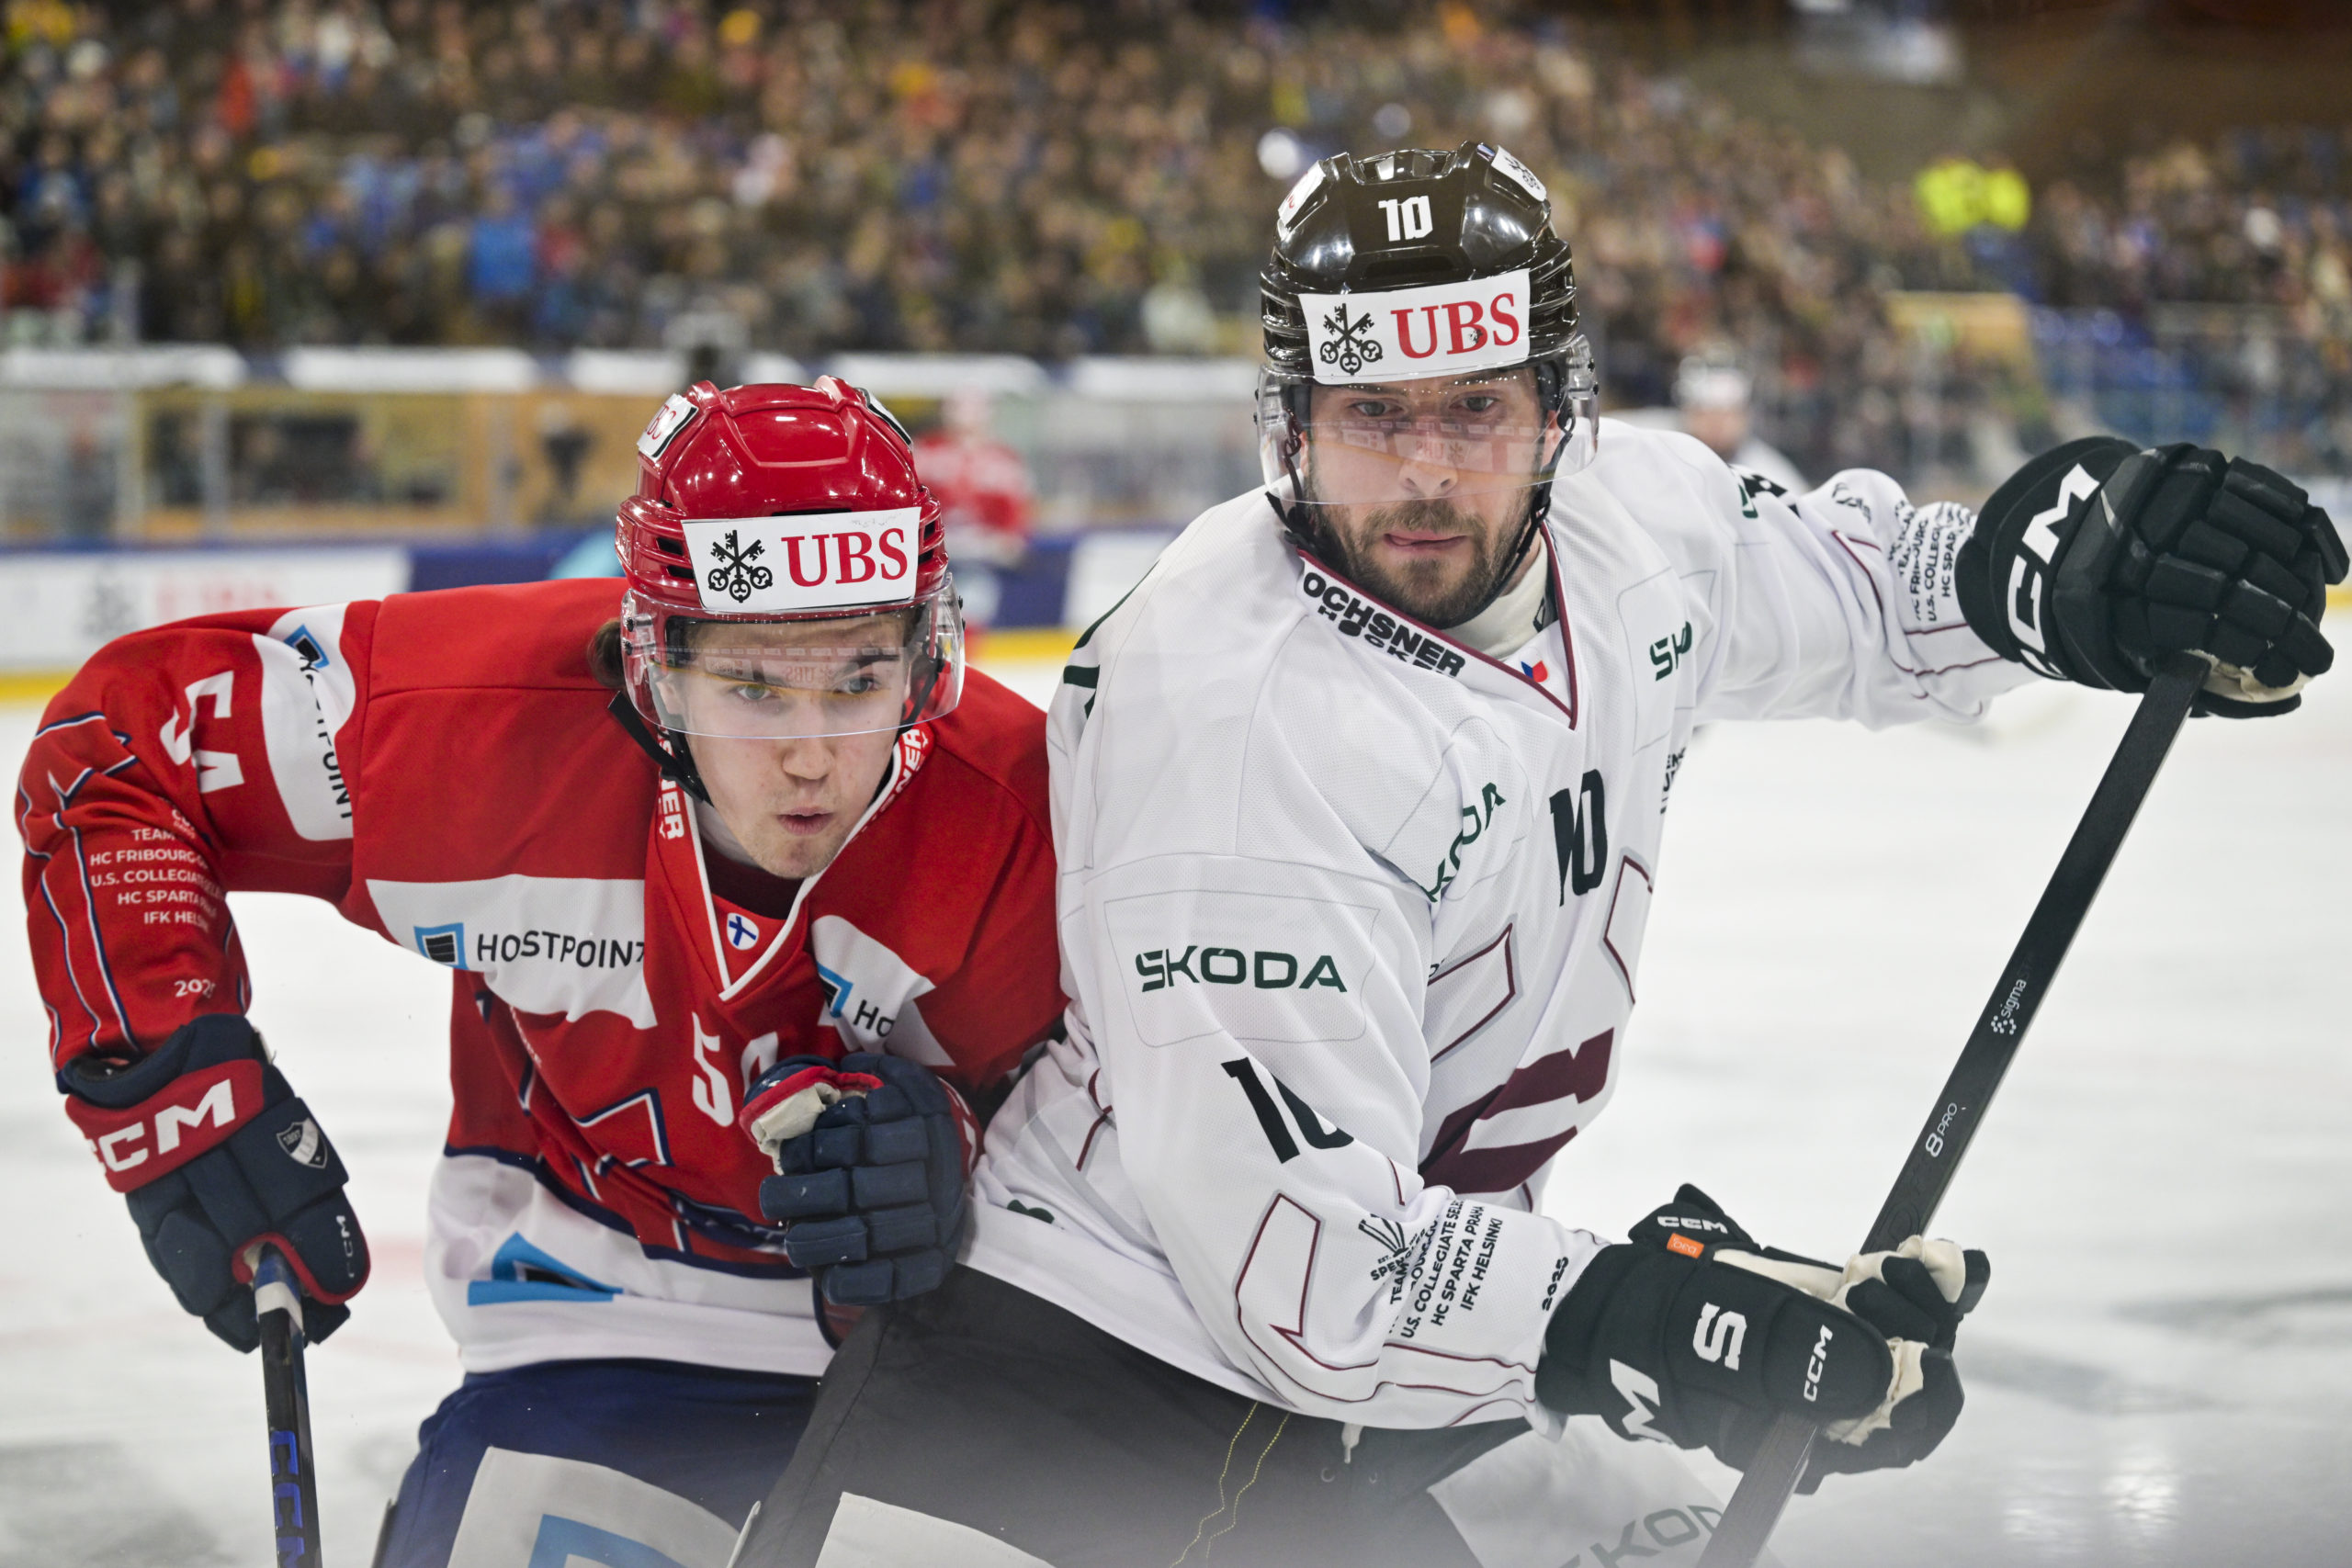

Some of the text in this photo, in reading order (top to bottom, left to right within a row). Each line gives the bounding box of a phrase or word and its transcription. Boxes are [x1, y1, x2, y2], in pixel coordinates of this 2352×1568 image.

[1379, 195, 1433, 242] 10
[1390, 293, 1521, 359] UBS
[781, 527, 909, 587] UBS
[1941, 575, 1951, 597] HC
[1303, 571, 1466, 678] OCHSNER
[89, 852, 112, 866] HC
[1425, 783, 1507, 902] KODA
[1549, 769, 1608, 907] 10
[91, 873, 120, 887] U.S.
[118, 891, 141, 905] HC
[146, 890, 199, 904] SPARTA
[144, 912, 171, 924] IFK
[2000, 978, 2027, 1018] sigma
[90, 1078, 236, 1172] CM
[1925, 1102, 1958, 1157] 8 PRO
[1390, 1262, 1410, 1305] TEAM
[1400, 1316, 1421, 1338] U.S.
[1414, 1221, 1457, 1313] COLLEGIATE
[1430, 1205, 1486, 1326] HC SPARTA PRAHA
[1460, 1217, 1503, 1311] IFK HELSINKI
[1542, 1256, 1569, 1312] 2025
[1803, 1324, 1834, 1403] CCM
